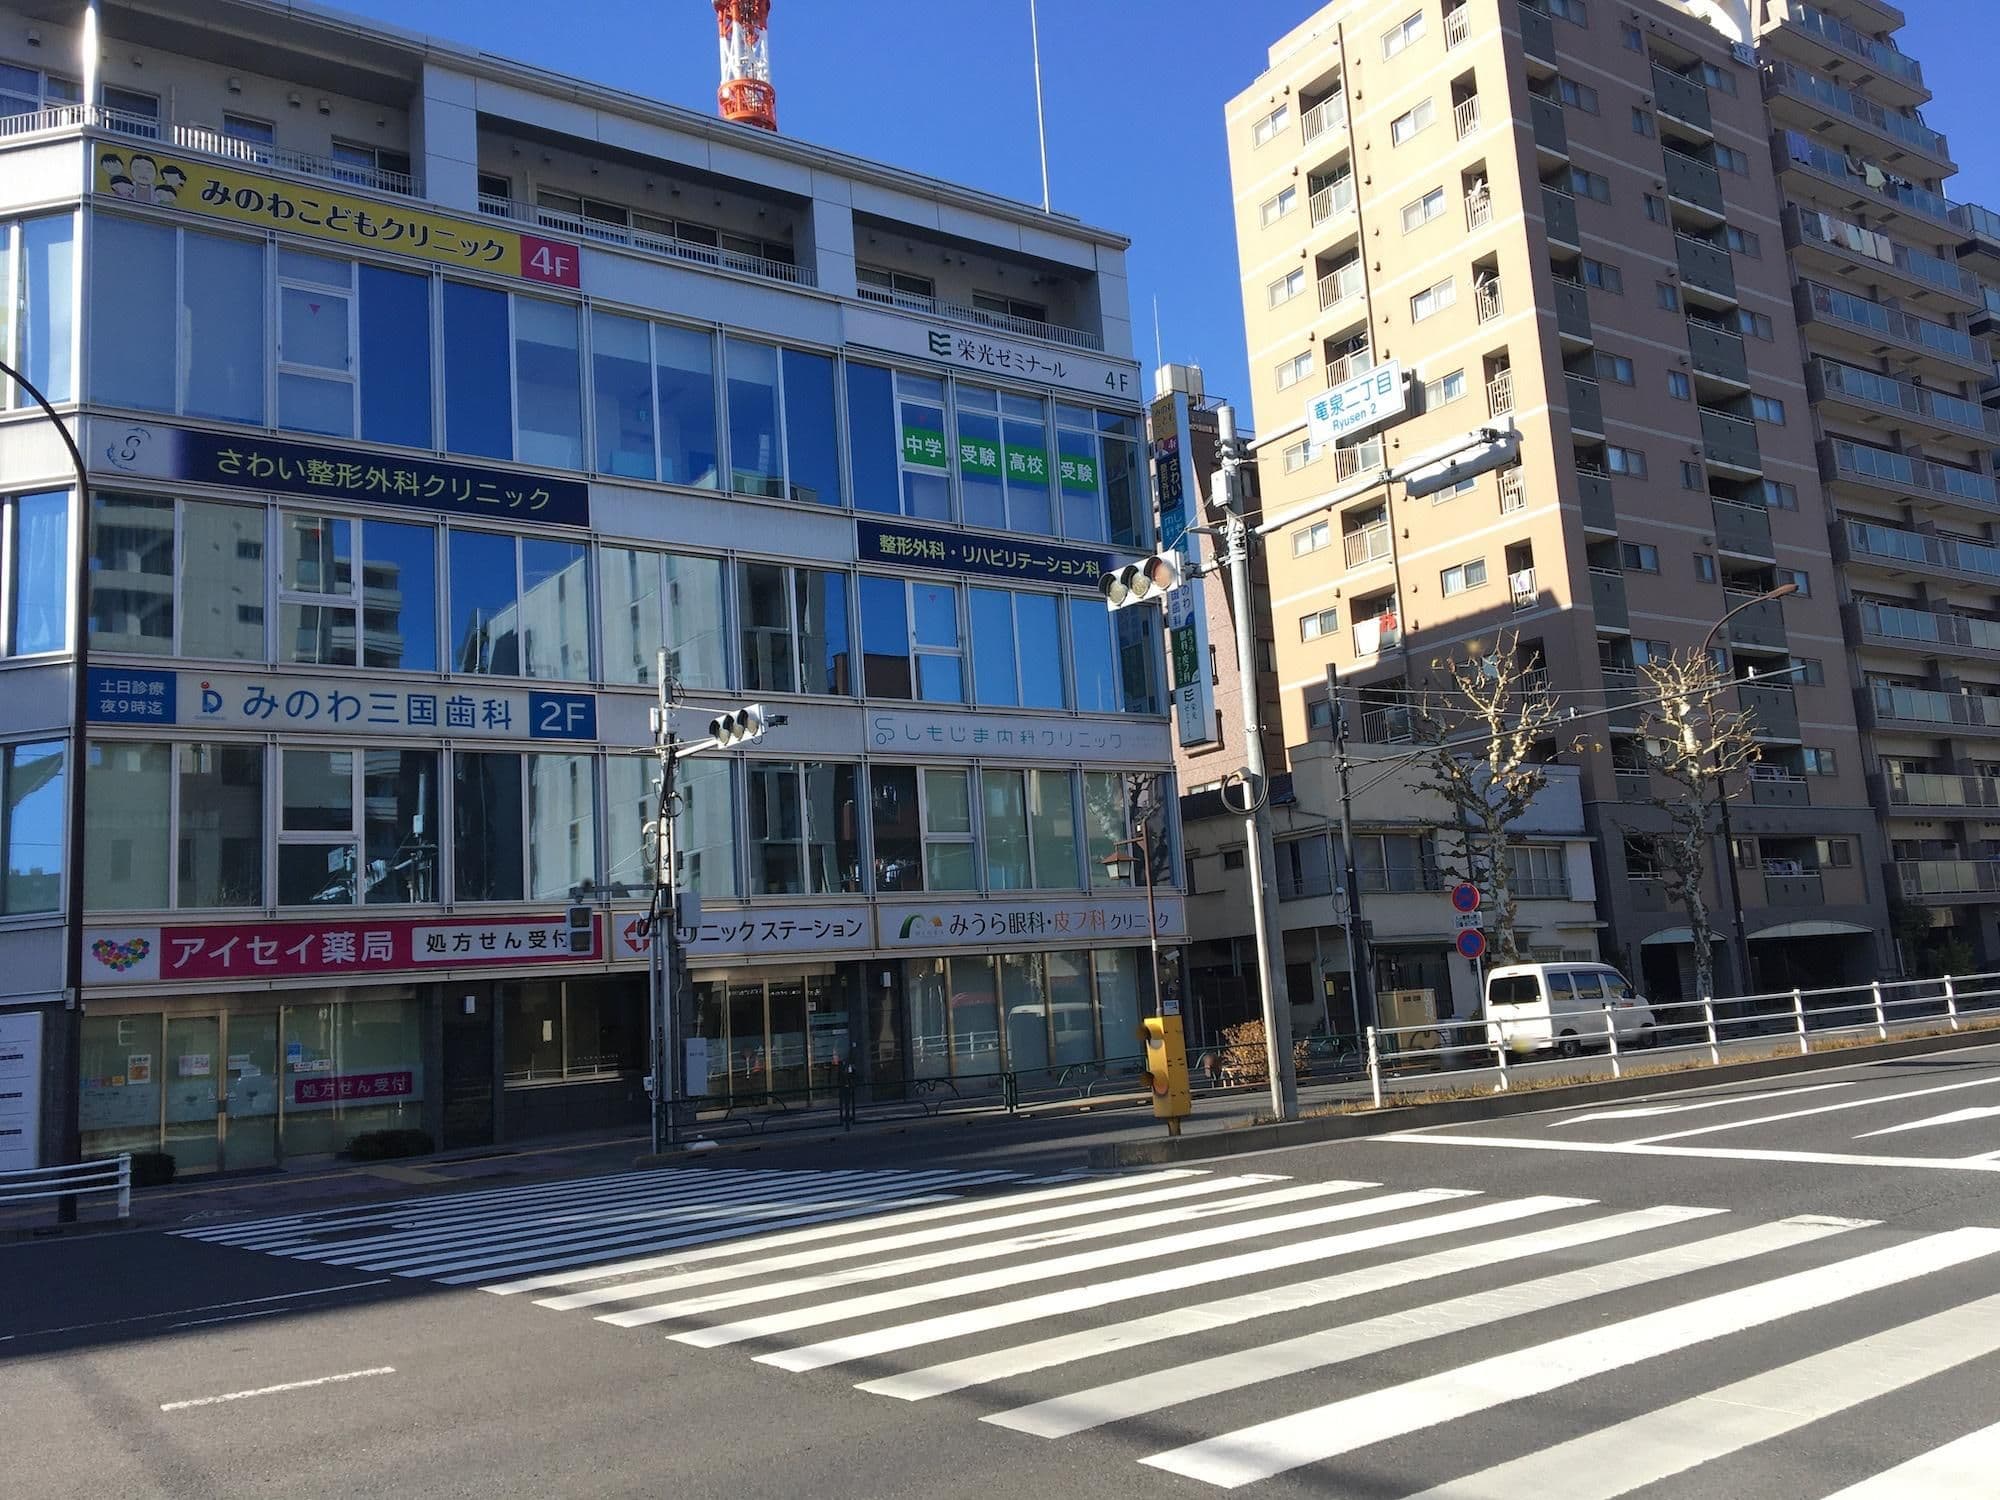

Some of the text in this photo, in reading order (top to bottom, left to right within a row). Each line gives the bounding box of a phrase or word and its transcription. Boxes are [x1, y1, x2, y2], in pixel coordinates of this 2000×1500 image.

[201, 178, 569, 277] みのわこどもクリニック 4F
[958, 338, 1128, 392] 栄光ゼミナール 4F
[1314, 370, 1392, 421] 竜泉二丁目
[1332, 403, 1377, 431] Ryusen 2
[217, 448, 551, 511] さわい整形外科クリニック
[906, 435, 1094, 484] 中学 受験 高校 受験
[879, 534, 1101, 579] 整形外科・リハビリテーション科
[100, 680, 164, 695] 土日診療
[100, 699, 163, 715] 夜9時迄
[243, 686, 586, 732] みのわ三国歯科 2F
[905, 723, 1122, 749] しもじま内科クリニック
[171, 930, 393, 968] アイセイ薬局
[302, 1077, 406, 1098] 処方せん受付
